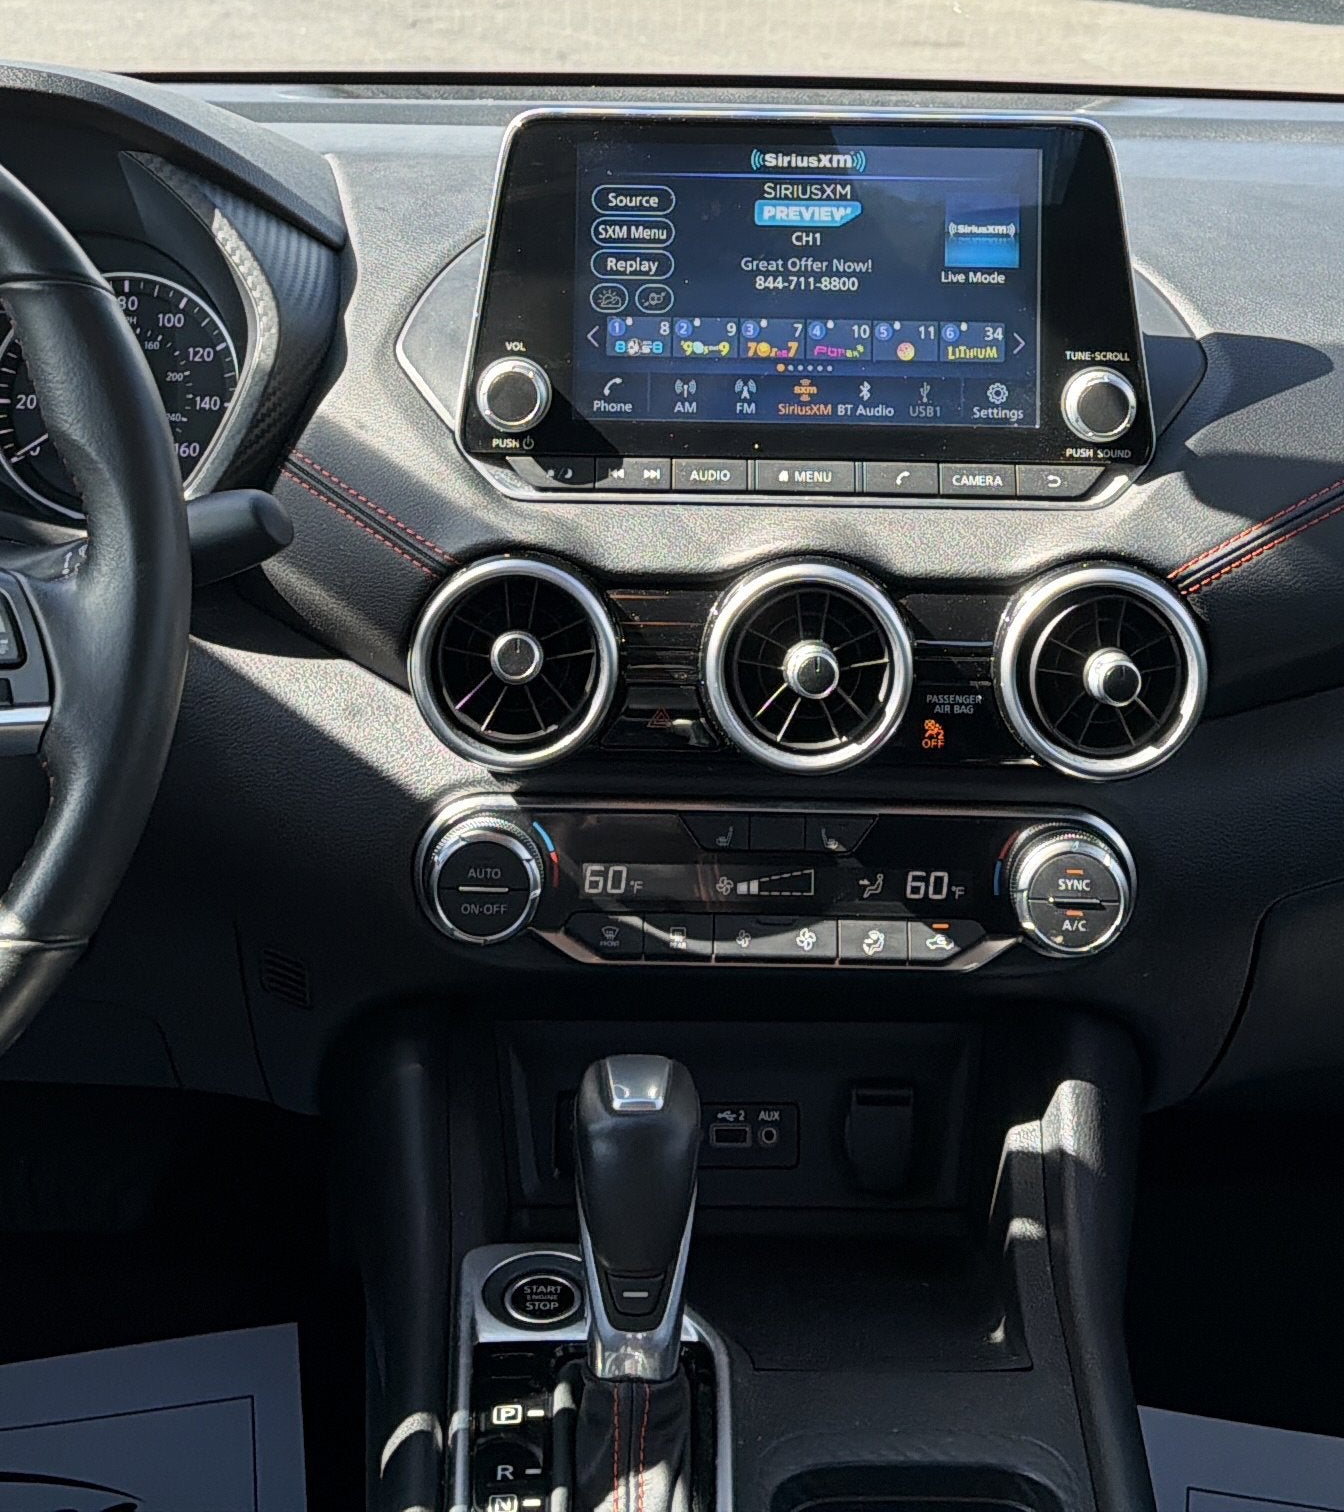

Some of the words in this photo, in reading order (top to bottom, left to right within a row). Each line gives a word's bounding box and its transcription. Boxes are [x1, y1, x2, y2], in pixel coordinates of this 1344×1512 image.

[763, 182, 852, 200] SIRIUSXM
[608, 193, 659, 207] Source
[763, 205, 852, 221] PREVIEW
[598, 225, 628, 239] SXM
[631, 225, 667, 240] Menu
[792, 232, 821, 246] CH1
[607, 258, 659, 275] Replay
[741, 257, 783, 272] Great
[787, 258, 829, 273] Offer
[833, 259, 873, 273] Now!
[756, 276, 859, 291] 844-711-8800
[941, 271, 966, 284] Live
[969, 271, 1006, 284] Mode
[117, 295, 138, 311] 80
[157, 313, 185, 328] 100
[614, 322, 620, 333] 1
[659, 321, 670, 335] 8
[679, 323, 688, 334] 2
[726, 322, 737, 336] 9
[747, 324, 755, 336] 3
[792, 324, 803, 337] 7
[813, 325, 822, 336] 4
[852, 324, 871, 338] 10
[879, 326, 888, 338] 5
[919, 326, 935, 339] 11
[946, 327, 955, 338] 6
[984, 326, 1003, 341] 34
[144, 341, 160, 350] 160
[505, 341, 526, 352] VOL
[188, 347, 214, 362] 120
[166, 372, 184, 382] 200
[15, 394, 37, 410] 20
[195, 395, 221, 411] 140
[593, 399, 633, 412] Phone
[674, 402, 697, 413] AM
[736, 403, 756, 414] FM
[778, 403, 832, 416] SiriusXM
[837, 404, 854, 416] BT
[856, 404, 895, 417] Audio
[972, 406, 1024, 421] Settings
[492, 438, 520, 449] PUSH
[1065, 448, 1094, 458] PUSH
[1097, 448, 1132, 459] SOUND
[689, 470, 731, 482] AUDIO
[794, 470, 832, 483] MENU
[952, 474, 1003, 487] CAMERA
[926, 694, 982, 704] PASSENGER
[934, 704, 951, 714] AIR
[953, 704, 975, 715] BAG
[922, 738, 945, 749] OFF
[467, 867, 502, 880] AUTO
[1058, 878, 1091, 892] SYNC
[1062, 919, 1087, 932] A/C
[738, 1110, 745, 1121] 2
[758, 1110, 780, 1121] AUX
[523, 1285, 562, 1295] START
[525, 1302, 559, 1311] STOP
[496, 1464, 514, 1481] R
